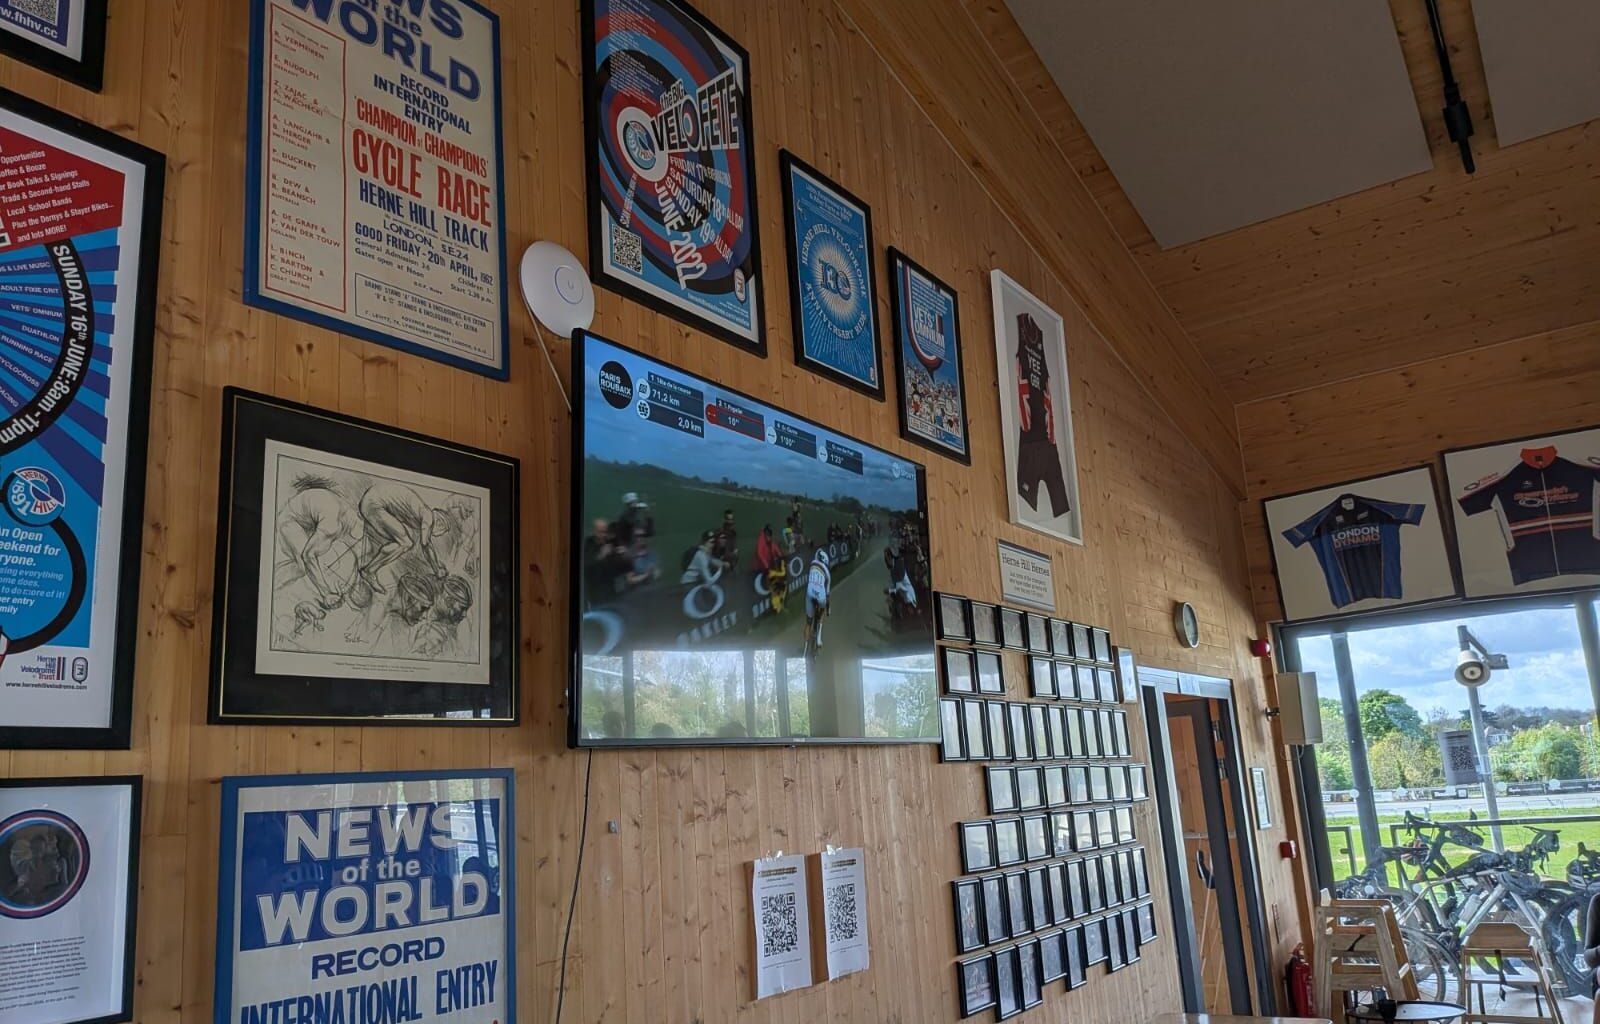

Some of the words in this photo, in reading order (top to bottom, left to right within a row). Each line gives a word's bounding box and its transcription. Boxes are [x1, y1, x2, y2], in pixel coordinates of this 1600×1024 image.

[384, 4, 422, 38] the
[284, 59, 319, 80] RUDOLPH
[400, 73, 449, 108] RECORD
[373, 74, 472, 135] INTERNATIONAL
[404, 107, 444, 134] ENTRY
[0, 150, 46, 166] Opportunities
[670, 156, 696, 178] FRIDAY
[25, 163, 47, 175] Booze
[353, 128, 422, 199] CYCLE
[437, 165, 492, 228] RACE
[7, 179, 25, 190] Book
[25, 175, 43, 187] Talks
[50, 170, 78, 184] Signings
[72, 180, 90, 192] Stalls
[671, 169, 713, 213] SATURDAY
[7, 206, 26, 217] Local
[28, 201, 51, 214] School
[52, 196, 73, 209] Bands
[654, 182, 685, 237] JUNE
[665, 176, 703, 228] SUNDAY
[12, 219, 28, 231] Plus
[29, 217, 39, 228] the
[359, 179, 404, 218] HERNE
[409, 200, 438, 234] HILL
[443, 215, 489, 253] TRACK
[17, 232, 31, 243] and
[32, 229, 44, 241] lots
[44, 225, 68, 238] MORE!
[354, 238, 382, 254] General
[355, 222, 382, 244] GOOD
[386, 233, 420, 259] FRIDAY
[449, 259, 478, 282] APRIL,
[13, 263, 29, 271] LIVE
[29, 260, 51, 270] MUSIC
[669, 231, 708, 291] 2022
[53, 244, 88, 312] SUNDAY
[354, 248, 376, 261] Gates
[450, 283, 467, 296] Start
[21, 324, 60, 343] DUATHLON
[1, 334, 34, 354] RUNNING
[599, 369, 621, 384] PARIS
[600, 378, 632, 397] ROUBAIX
[651, 388, 668, 400] 71,2
[669, 394, 680, 407] km
[690, 421, 702, 434] km
[31, 499, 58, 514] HILL
[12, 528, 44, 543] Open
[1332, 525, 1380, 542] LONDON
[44, 544, 61, 558] for
[18, 569, 65, 582] everything
[1, 585, 9, 594] to
[10, 585, 22, 594] do
[23, 587, 46, 597] more
[46, 587, 56, 598] of
[12, 598, 36, 610] entry
[284, 802, 470, 864] NEWS
[342, 858, 370, 885] of
[378, 858, 420, 881] the
[257, 870, 491, 946] WORLD
[312, 936, 446, 981] RECORD
[436, 959, 498, 1016] ENTRY
